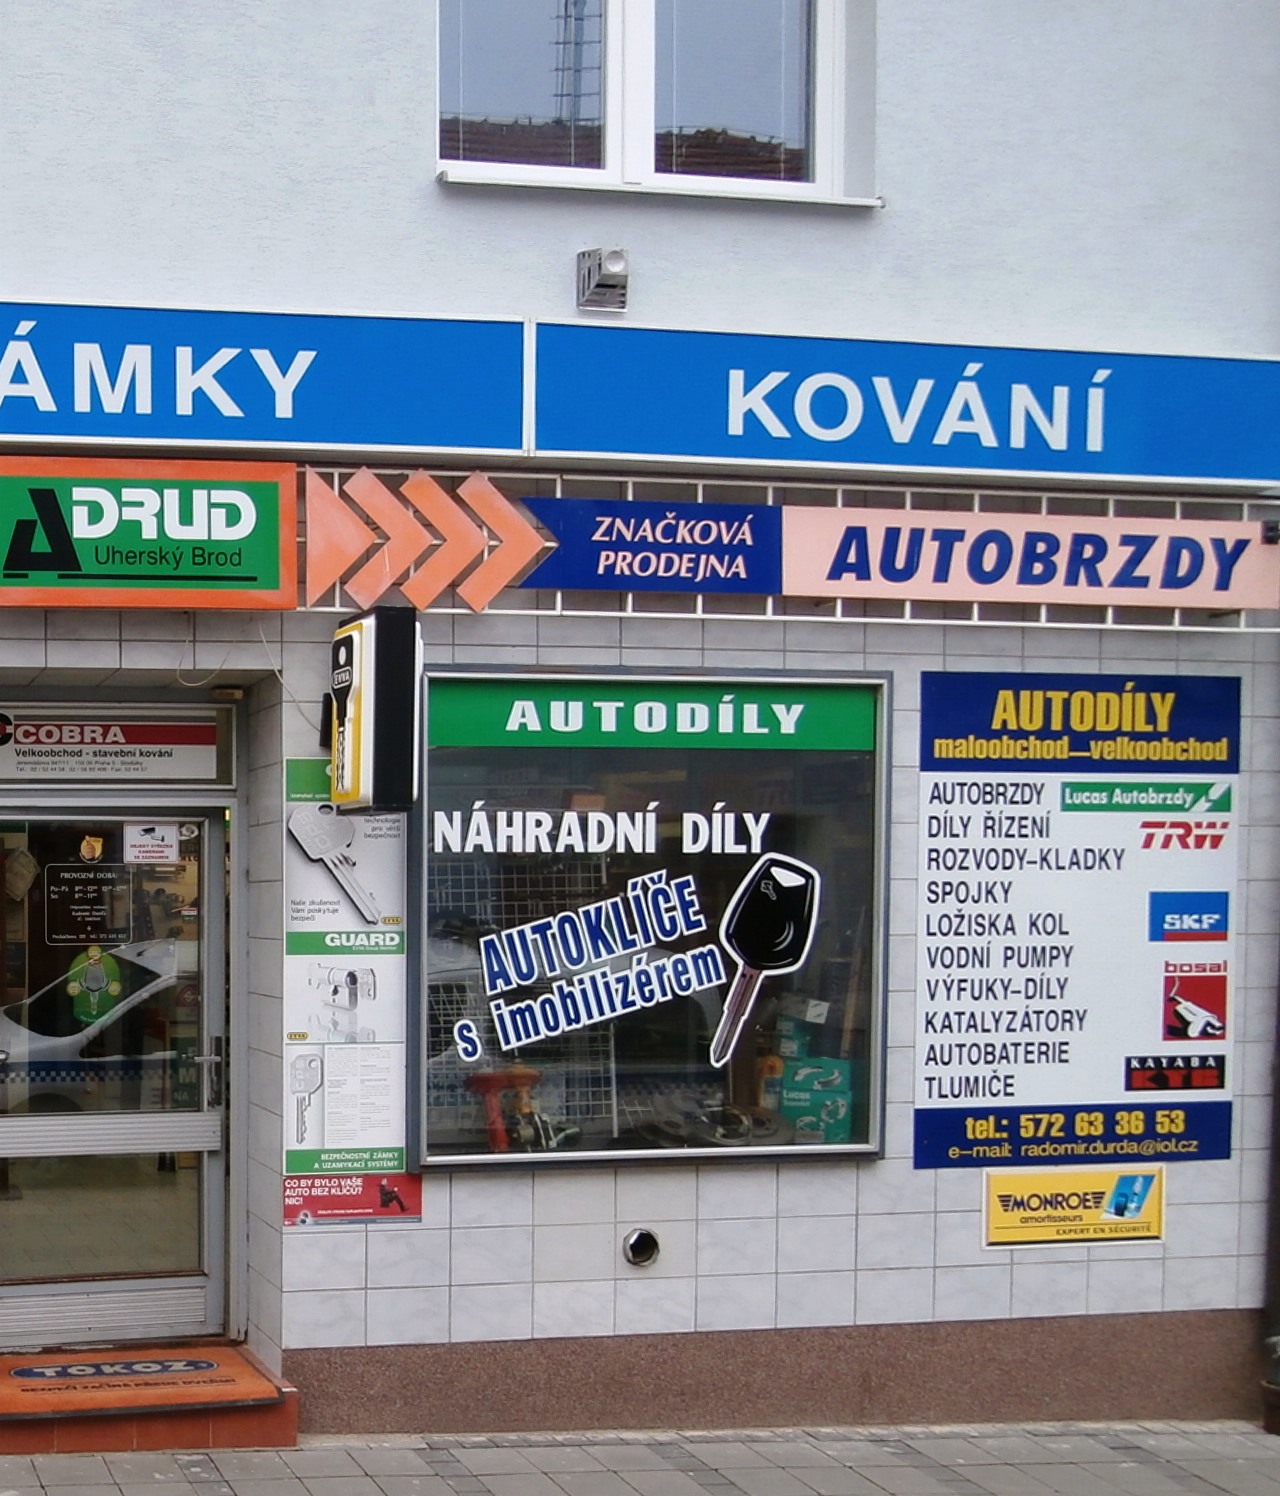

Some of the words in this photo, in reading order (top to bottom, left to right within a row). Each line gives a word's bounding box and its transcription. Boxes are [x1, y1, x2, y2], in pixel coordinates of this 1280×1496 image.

[727, 362, 1113, 453] KOVÁNÍ
[591, 511, 754, 547] ZNAČKOVÁ
[94, 544, 184, 572] Uherský
[191, 546, 243, 569] Brod
[596, 550, 749, 582] PRODEJNA
[826, 525, 1252, 593] AUTOBRZDY
[505, 694, 806, 735] AUTODÍLY
[991, 681, 1176, 732] AUTODÍLY
[15, 724, 127, 744] COBRA
[15, 748, 83, 758] Velkoobchod
[92, 748, 137, 758] stavební
[139, 748, 173, 758] kování
[928, 782, 1045, 805] AUTOBRZDY
[1064, 787, 1108, 804] Lucas
[1112, 787, 1194, 809] Autobrzdy
[433, 800, 660, 853] NÁHRADNÍ
[682, 801, 771, 854] DÍLY
[927, 810, 972, 838] DÍLY
[982, 810, 1051, 839] ŘÍZENÍ
[1139, 820, 1230, 849] TRW
[927, 848, 1126, 871] ROZVODY-KLADKY
[926, 881, 1013, 904] SPOJKY
[480, 868, 708, 996] AUTOKLÍČE
[926, 909, 1017, 937] LOŽISKA
[1028, 913, 1070, 936] KOL
[1162, 913, 1221, 930] SKF
[324, 933, 400, 946] GUARD
[927, 941, 992, 969] VODNÍ
[1003, 945, 1074, 968] PUMPY
[1164, 960, 1228, 973] bosal
[926, 972, 1070, 1001] VÝFUKY-DÍLY
[453, 1019, 482, 1062] s
[489, 943, 727, 1051] imobilizérem
[924, 1006, 1088, 1034] KATALYZÁTORY
[924, 1041, 1070, 1066] AUTOBATERIE
[1130, 1056, 1216, 1068] KAYABA
[783, 1090, 811, 1099] Lucas
[924, 1069, 1015, 1099] TLUMIČE
[965, 1114, 1009, 1140] tel.:
[1020, 1112, 1065, 1138] 572
[1074, 1111, 1104, 1136] 63
[1115, 1110, 1145, 1135] 36
[1155, 1109, 1186, 1134] 53
[321, 1151, 371, 1160] BEZPEČNOSTNÍ
[373, 1151, 399, 1159] ZÁMKY
[1020, 1138, 1199, 1157] radomir.durda@iol.cz
[322, 1160, 365, 1168] UZAMYKACÍ
[285, 1179, 299, 1188] CO
[300, 1179, 313, 1187] BY
[314, 1178, 338, 1187] BYLO
[285, 1188, 310, 1196] AUTO
[311, 1187, 330, 1195] BEZ
[285, 1197, 304, 1205] NIC!
[1010, 1192, 1093, 1212] MONROE
[1019, 1213, 1083, 1224] amortisseurs
[1056, 1227, 1090, 1236] EXPERT
[1093, 1226, 1106, 1234] EN
[33, 1359, 196, 1377] TOKOZ
